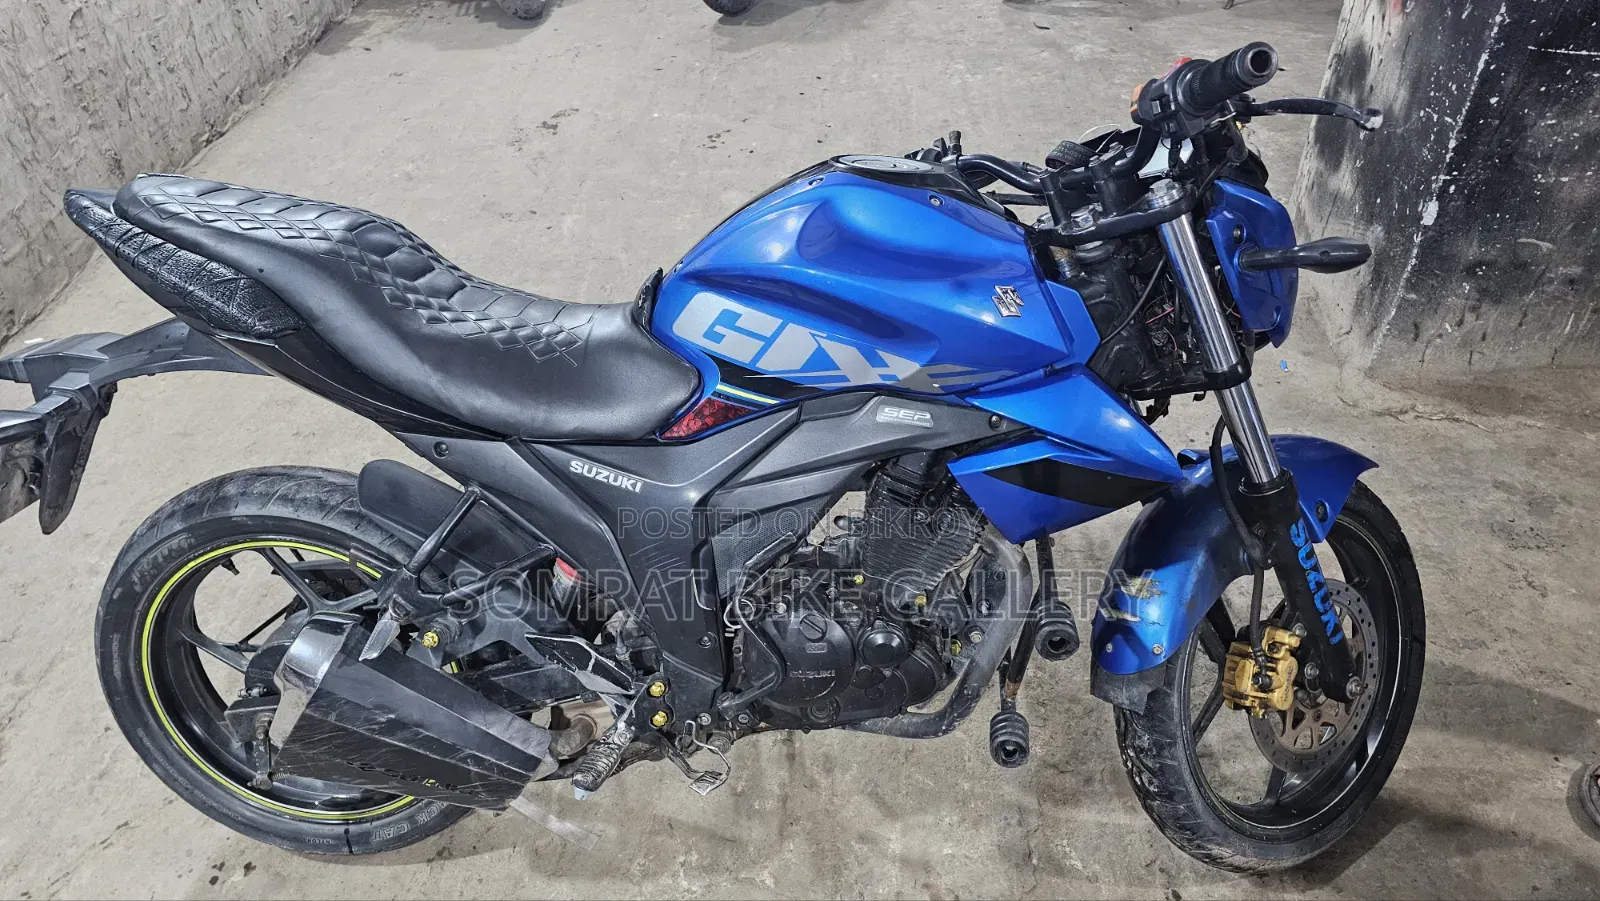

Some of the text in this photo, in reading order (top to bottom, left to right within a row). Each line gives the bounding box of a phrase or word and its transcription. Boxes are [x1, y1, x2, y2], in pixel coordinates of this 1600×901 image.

[882, 407, 931, 421] SEP
[569, 460, 643, 493] SUZUKI
[1290, 518, 1345, 645] SUZUKI
